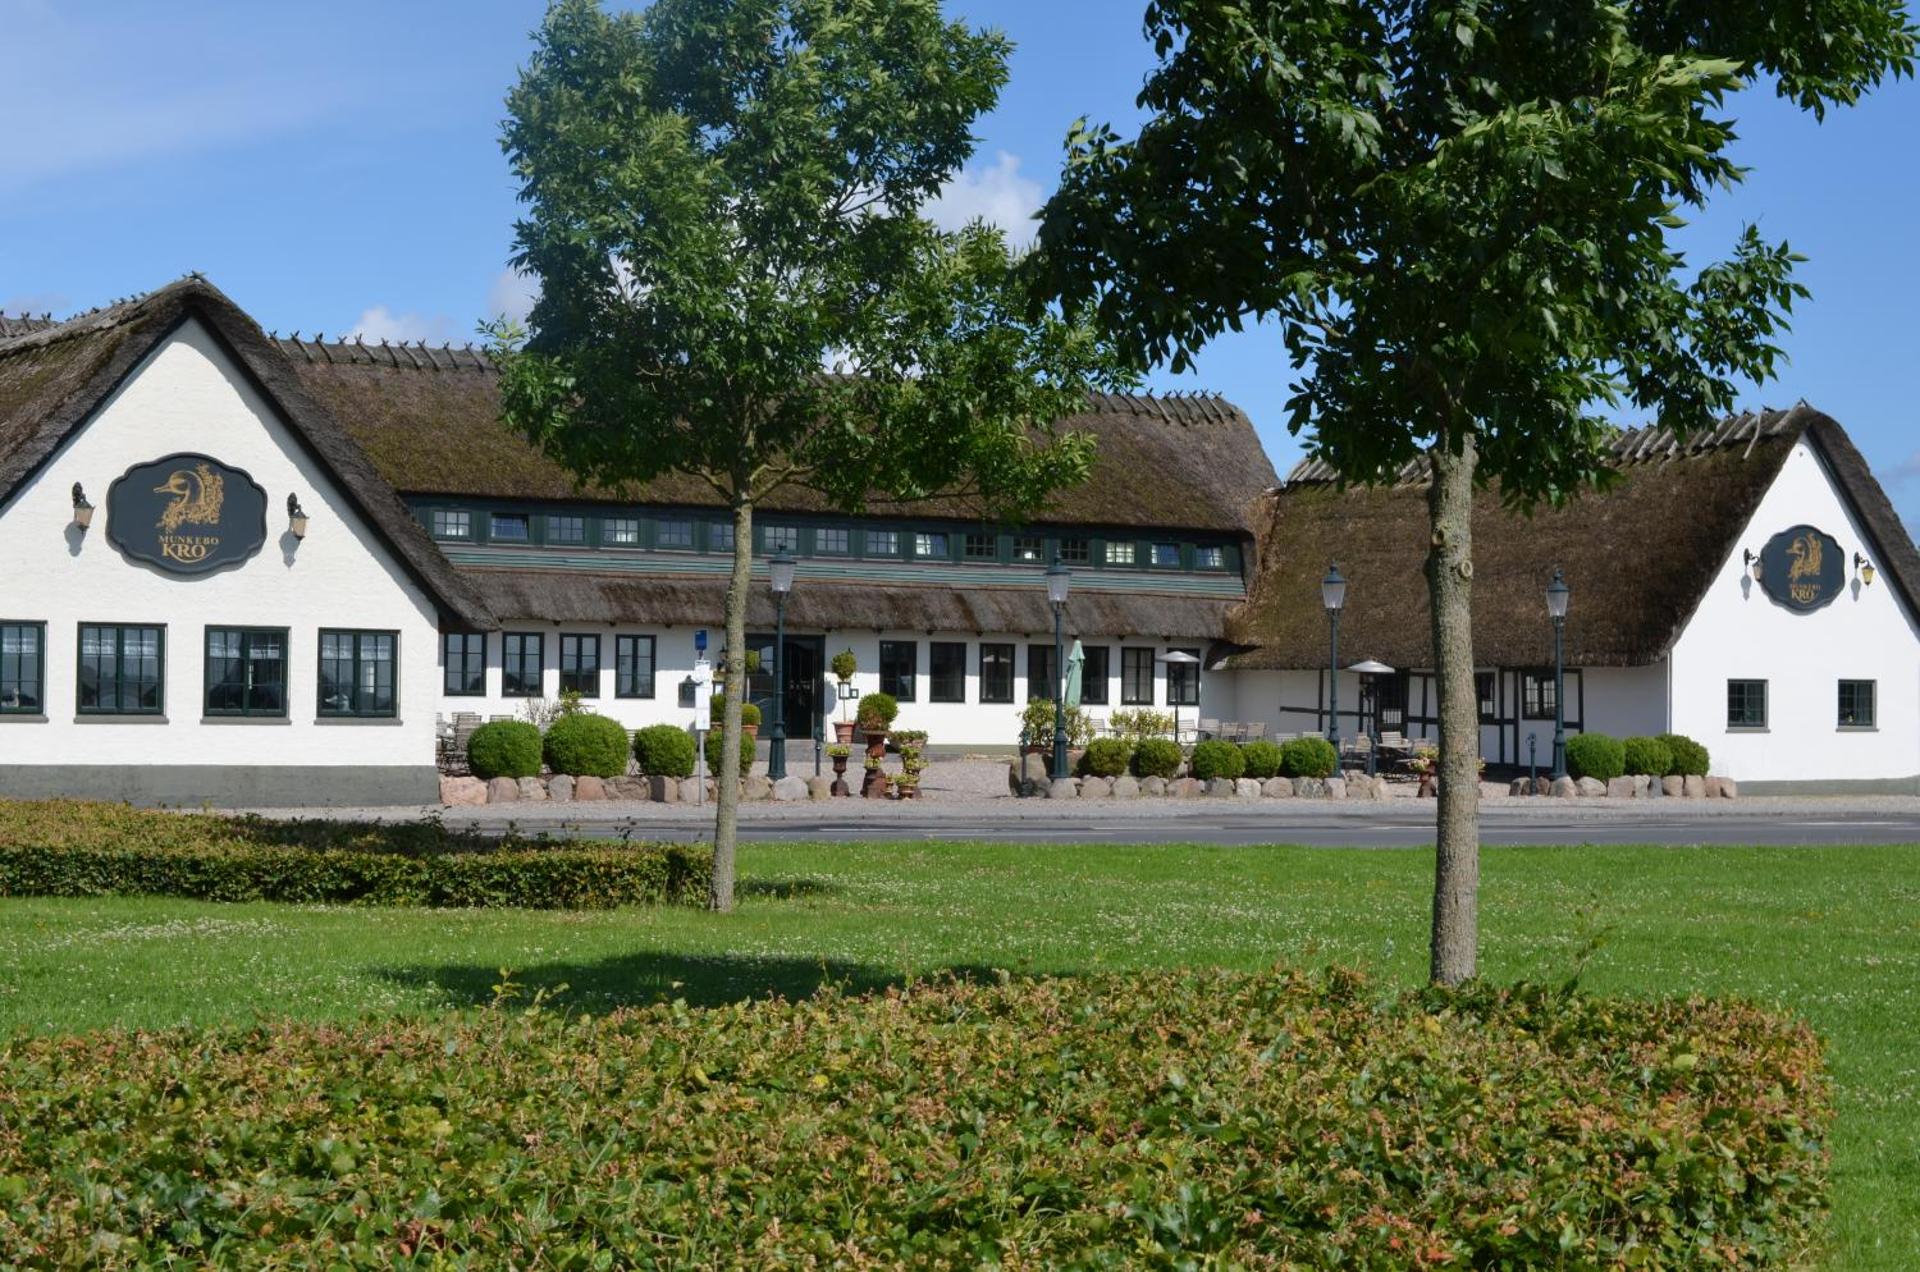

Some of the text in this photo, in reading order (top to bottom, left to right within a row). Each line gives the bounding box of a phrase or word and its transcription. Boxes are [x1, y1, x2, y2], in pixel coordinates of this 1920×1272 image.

[159, 535, 219, 545] MUNKEBO
[162, 544, 208, 560] KRO
[1791, 590, 1816, 601] KRO
